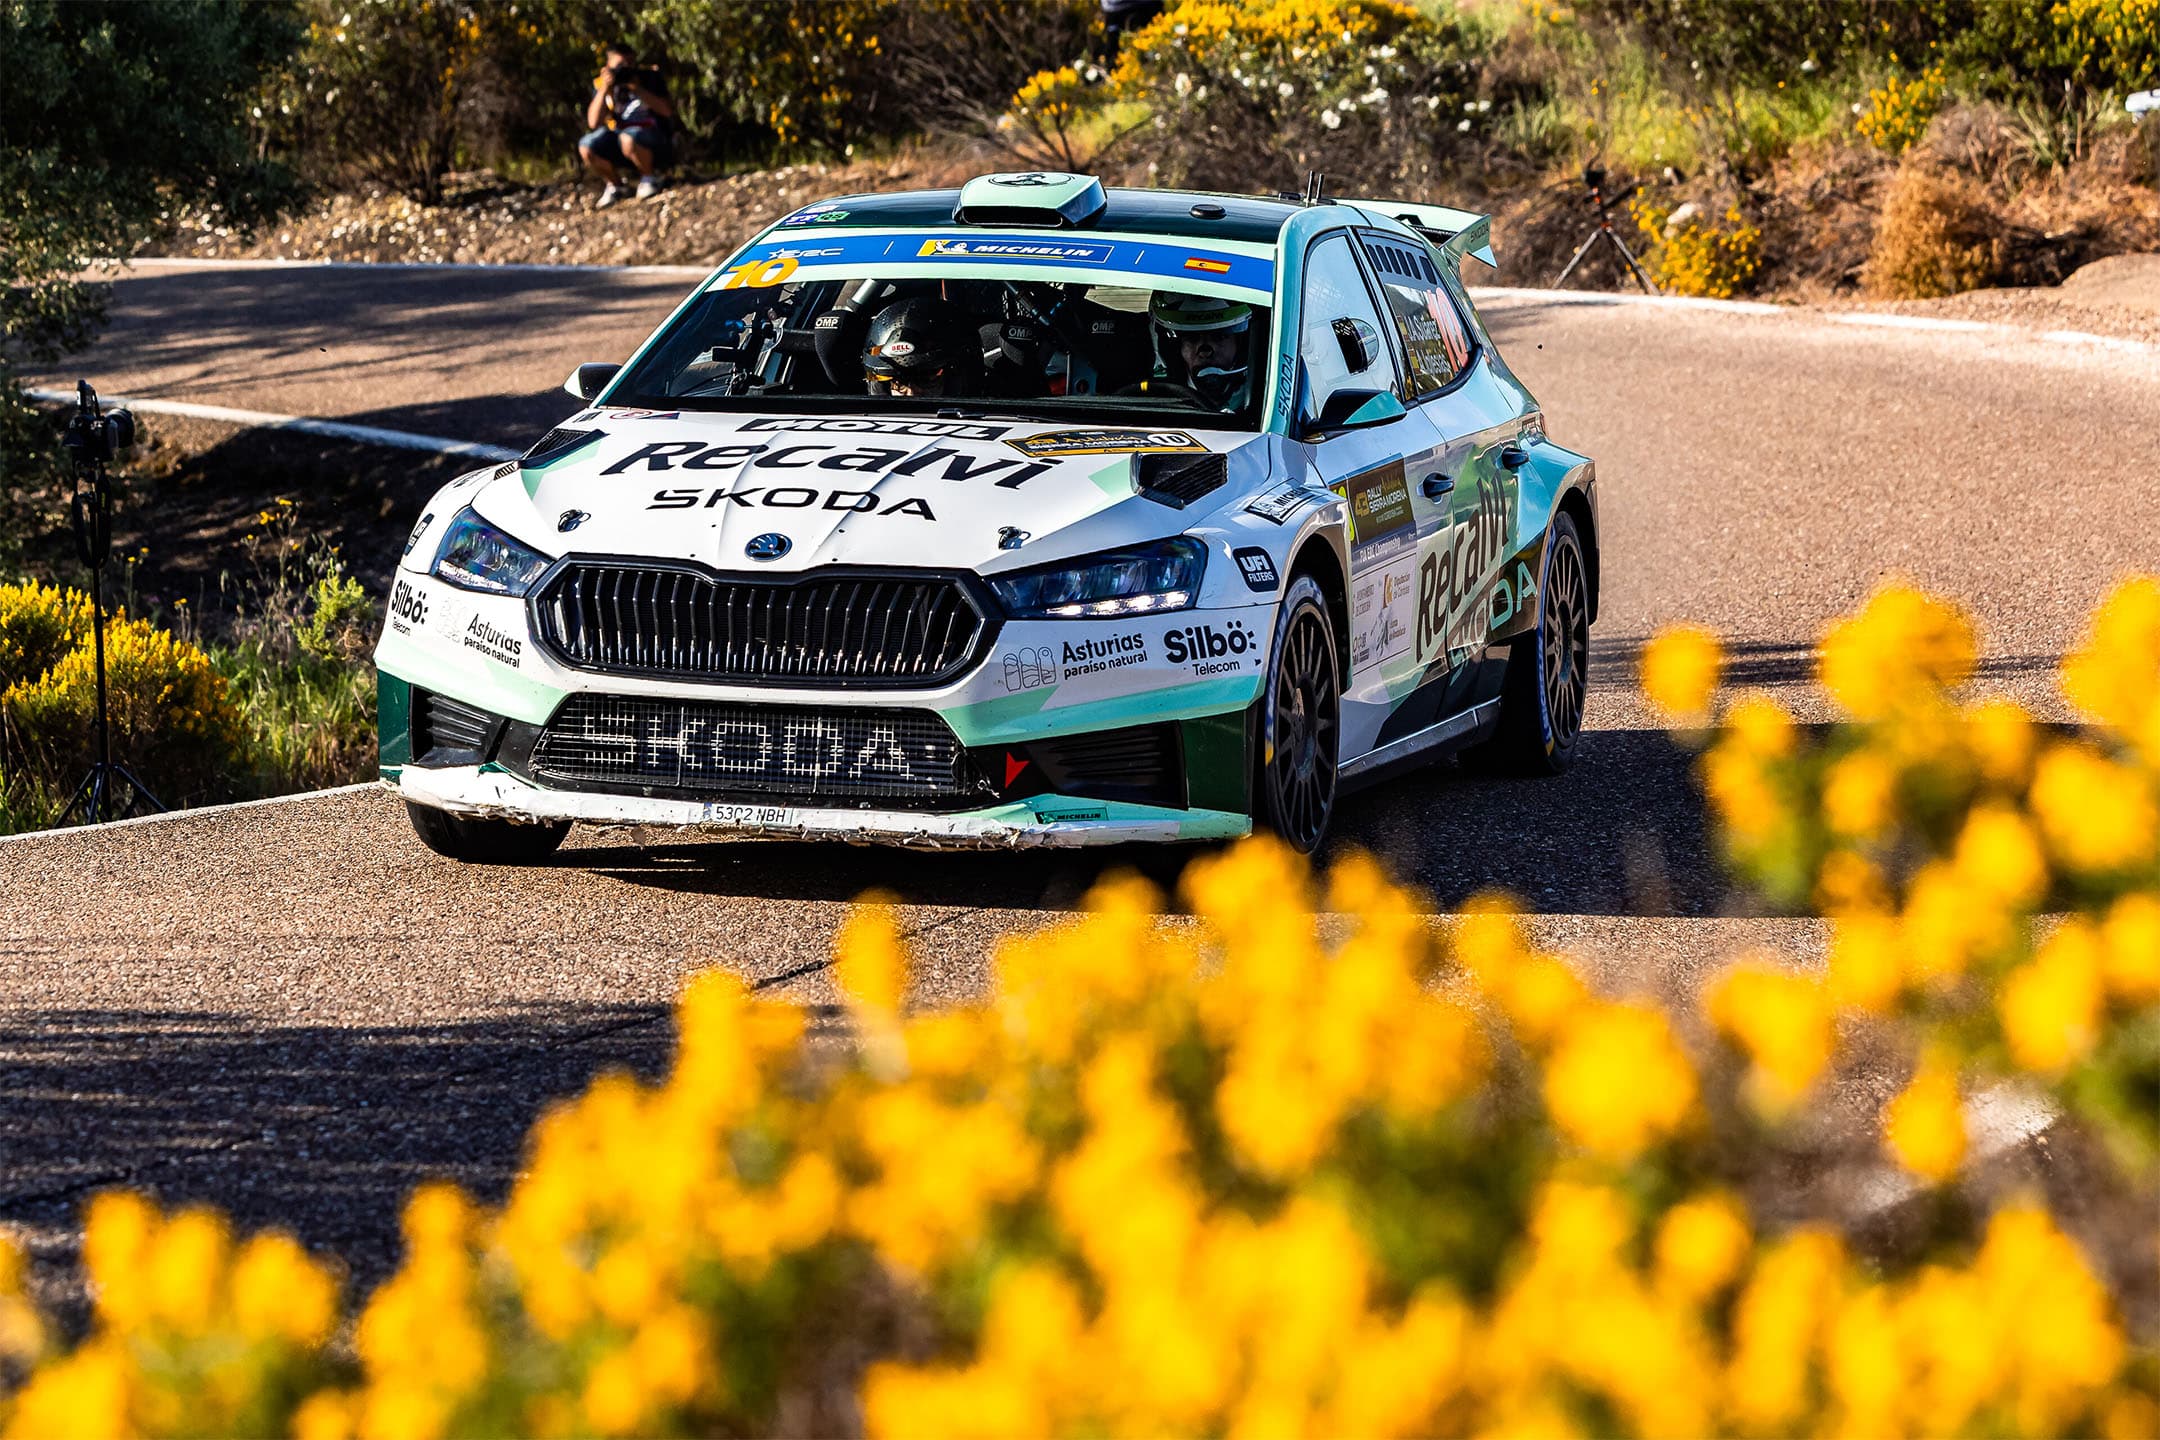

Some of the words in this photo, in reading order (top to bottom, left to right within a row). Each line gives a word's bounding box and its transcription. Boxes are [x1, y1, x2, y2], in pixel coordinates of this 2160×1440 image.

[973, 245, 1095, 257] MICHELIN
[724, 258, 799, 290] 10
[815, 317, 838, 328] OMP
[1092, 322, 1114, 332] OMP
[1009, 327, 1032, 338] OMP
[892, 344, 910, 352] BELL
[1278, 353, 1294, 416] SKODA
[752, 420, 993, 438] MOTUL
[1154, 435, 1183, 444] 10
[599, 441, 1063, 489] Recalvi
[646, 487, 937, 521] SKODA
[1240, 555, 1271, 572] UFI
[1416, 469, 1509, 664] Recalvi
[1247, 571, 1275, 583] FILTERS
[467, 613, 522, 655] Asturias
[1062, 631, 1145, 664] Asturias
[491, 650, 520, 668] natural
[1064, 661, 1107, 680] paraíso
[1108, 651, 1148, 669] natural
[1192, 661, 1241, 676] Telecom
[584, 713, 915, 780] SKODA
[756, 808, 786, 823] NBH
